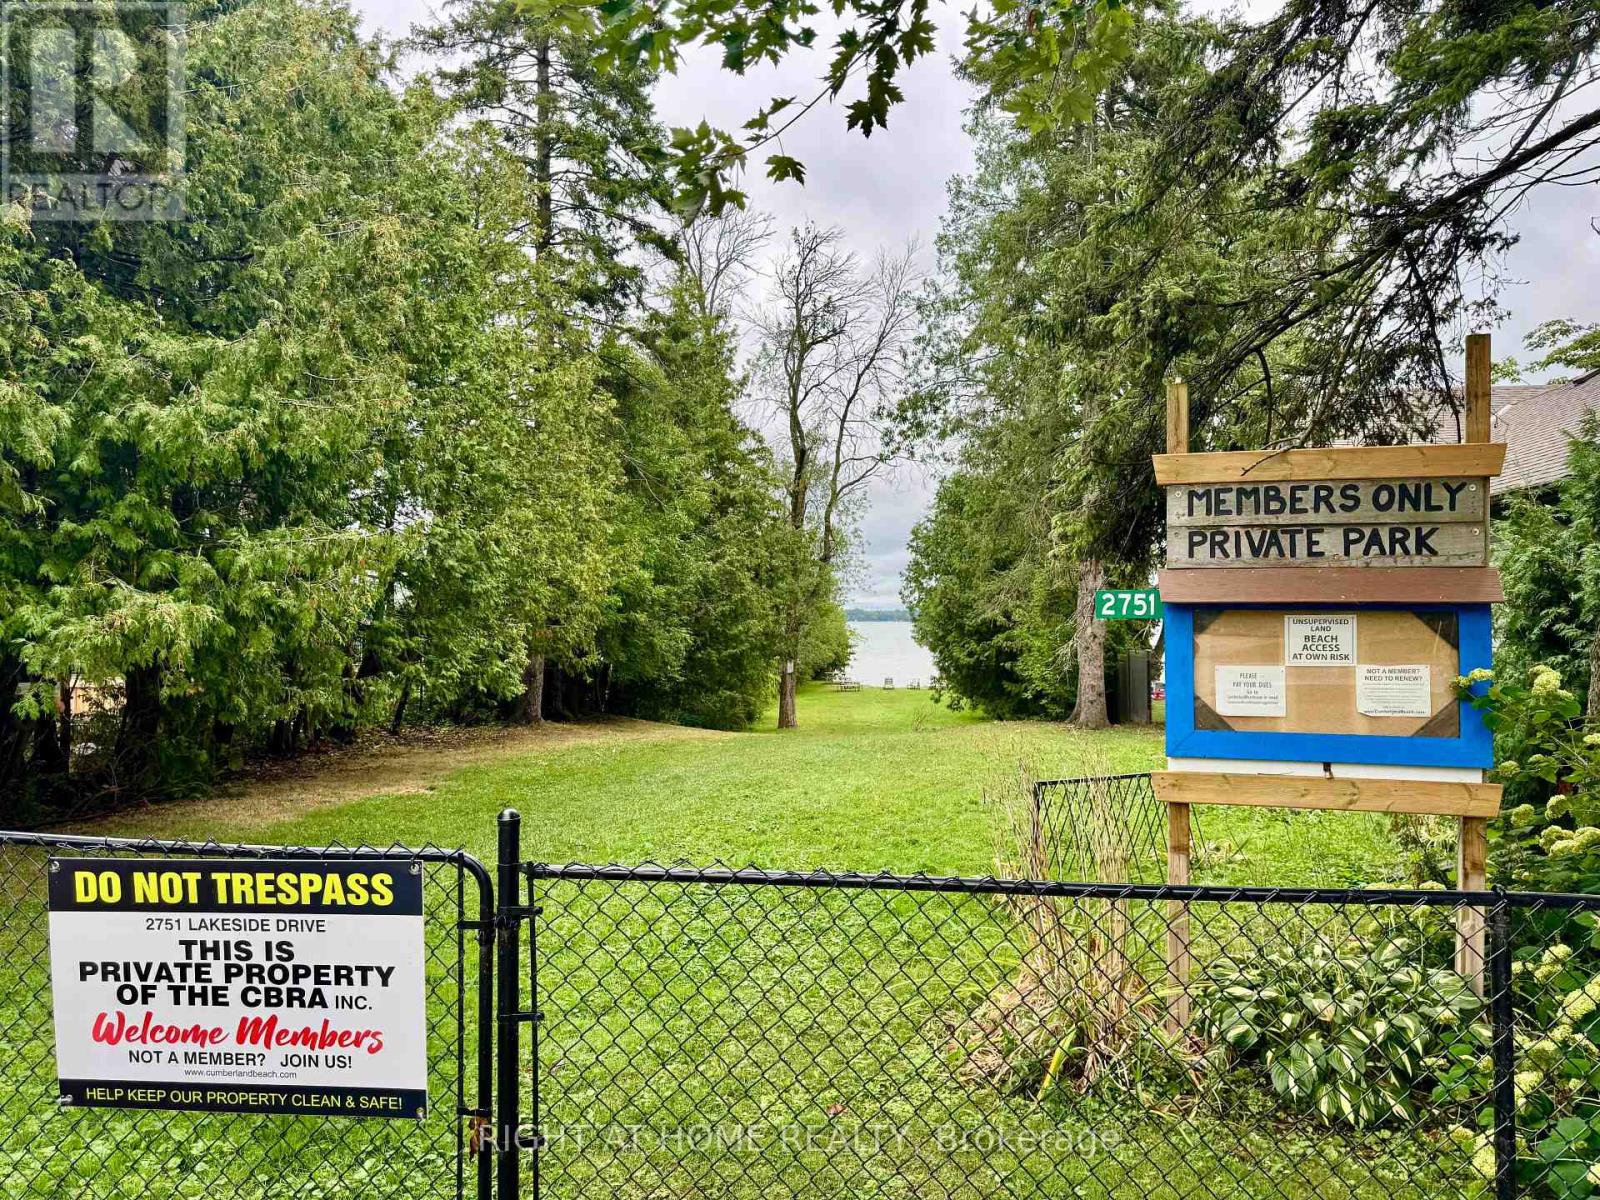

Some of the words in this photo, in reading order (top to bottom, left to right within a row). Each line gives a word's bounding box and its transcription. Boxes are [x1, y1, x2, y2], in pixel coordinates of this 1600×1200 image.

[1187, 484, 1361, 517] MEMBERS
[1372, 481, 1468, 513] ONLY
[1187, 528, 1325, 559] PRIVATE
[1343, 526, 1440, 557] PARK
[1101, 593, 1155, 616] 2751
[1301, 643, 1340, 652] ACCESS
[1304, 634, 1338, 643] BEACH
[1305, 653, 1328, 661] OWN
[1330, 653, 1350, 661] RISK
[74, 871, 122, 904] DO
[133, 872, 202, 905] NOT
[211, 872, 394, 906] TRESPASS
[146, 918, 181, 931] 2751
[188, 918, 271, 932] LAKESIDE
[276, 919, 326, 932] DRIVE
[178, 940, 253, 961] THIS
[264, 940, 295, 962] IS
[79, 961, 212, 983] PRIVATE
[224, 963, 396, 987] PROPERTY
[116, 984, 157, 1005] OF
[167, 985, 230, 1007] THE
[240, 986, 329, 1008] CBRA
[335, 995, 373, 1010] INC.
[92, 1010, 230, 1048] Welcome
[235, 1014, 384, 1055] Members
[129, 1050, 163, 1063] NOT
[168, 1051, 179, 1064] A
[184, 1051, 266, 1066] MEMBER?
[280, 1053, 319, 1067] JOIN
[325, 1055, 352, 1069] US!
[184, 1068, 297, 1079] www.cumberlandbeach.com
[86, 1088, 124, 1101] HELP
[128, 1089, 167, 1102] KEEP
[170, 1090, 203, 1104] OUR
[207, 1091, 288, 1105] PROPERTY
[292, 1094, 341, 1108] CLEAN
[345, 1095, 356, 1108] &
[359, 1096, 403, 1110] SAFE!
